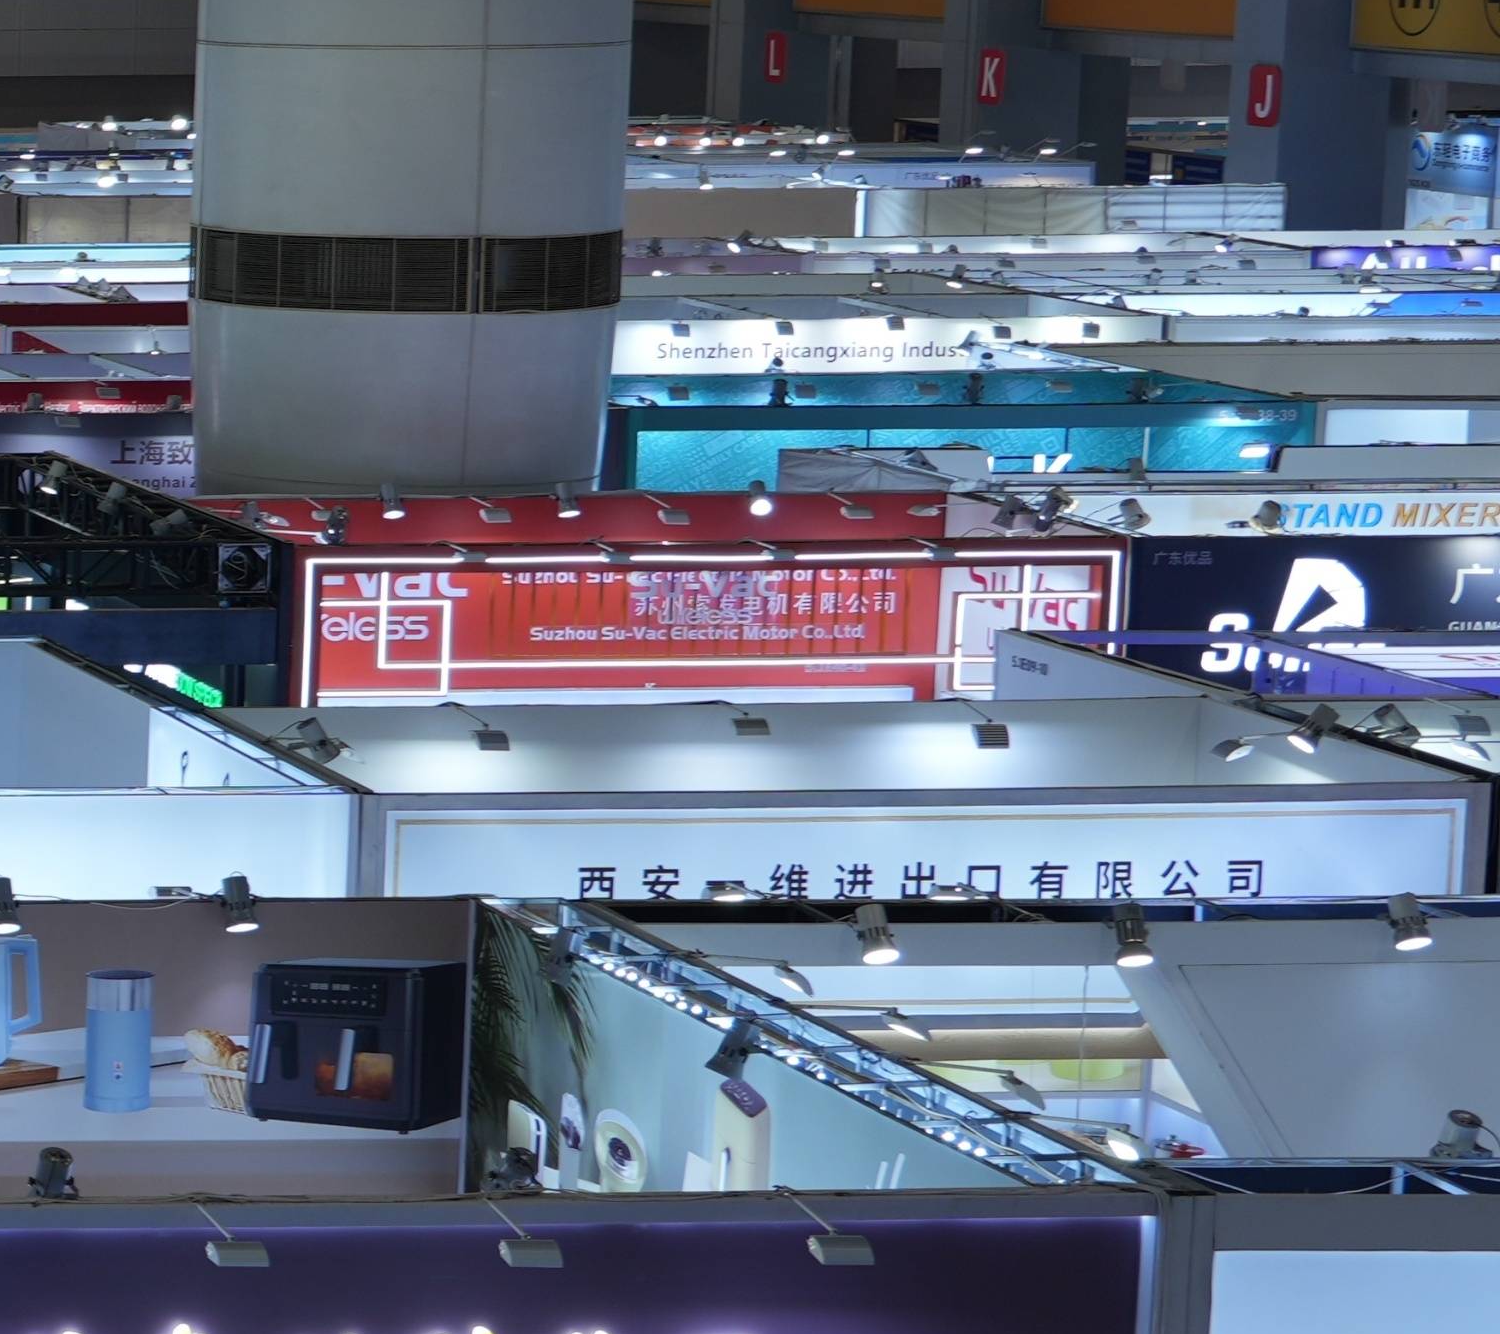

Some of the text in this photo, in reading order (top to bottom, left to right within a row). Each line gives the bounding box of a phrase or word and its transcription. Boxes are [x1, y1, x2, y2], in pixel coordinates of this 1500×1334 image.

[656, 342, 753, 360] Shenzhen
[761, 340, 895, 364] Taicangxiang
[1152, 548, 1213, 565] 广东优品
[530, 626, 598, 642] Suzhou
[601, 625, 668, 641] Su-Vac
[670, 625, 740, 641] Electric
[741, 624, 799, 641] Motor
